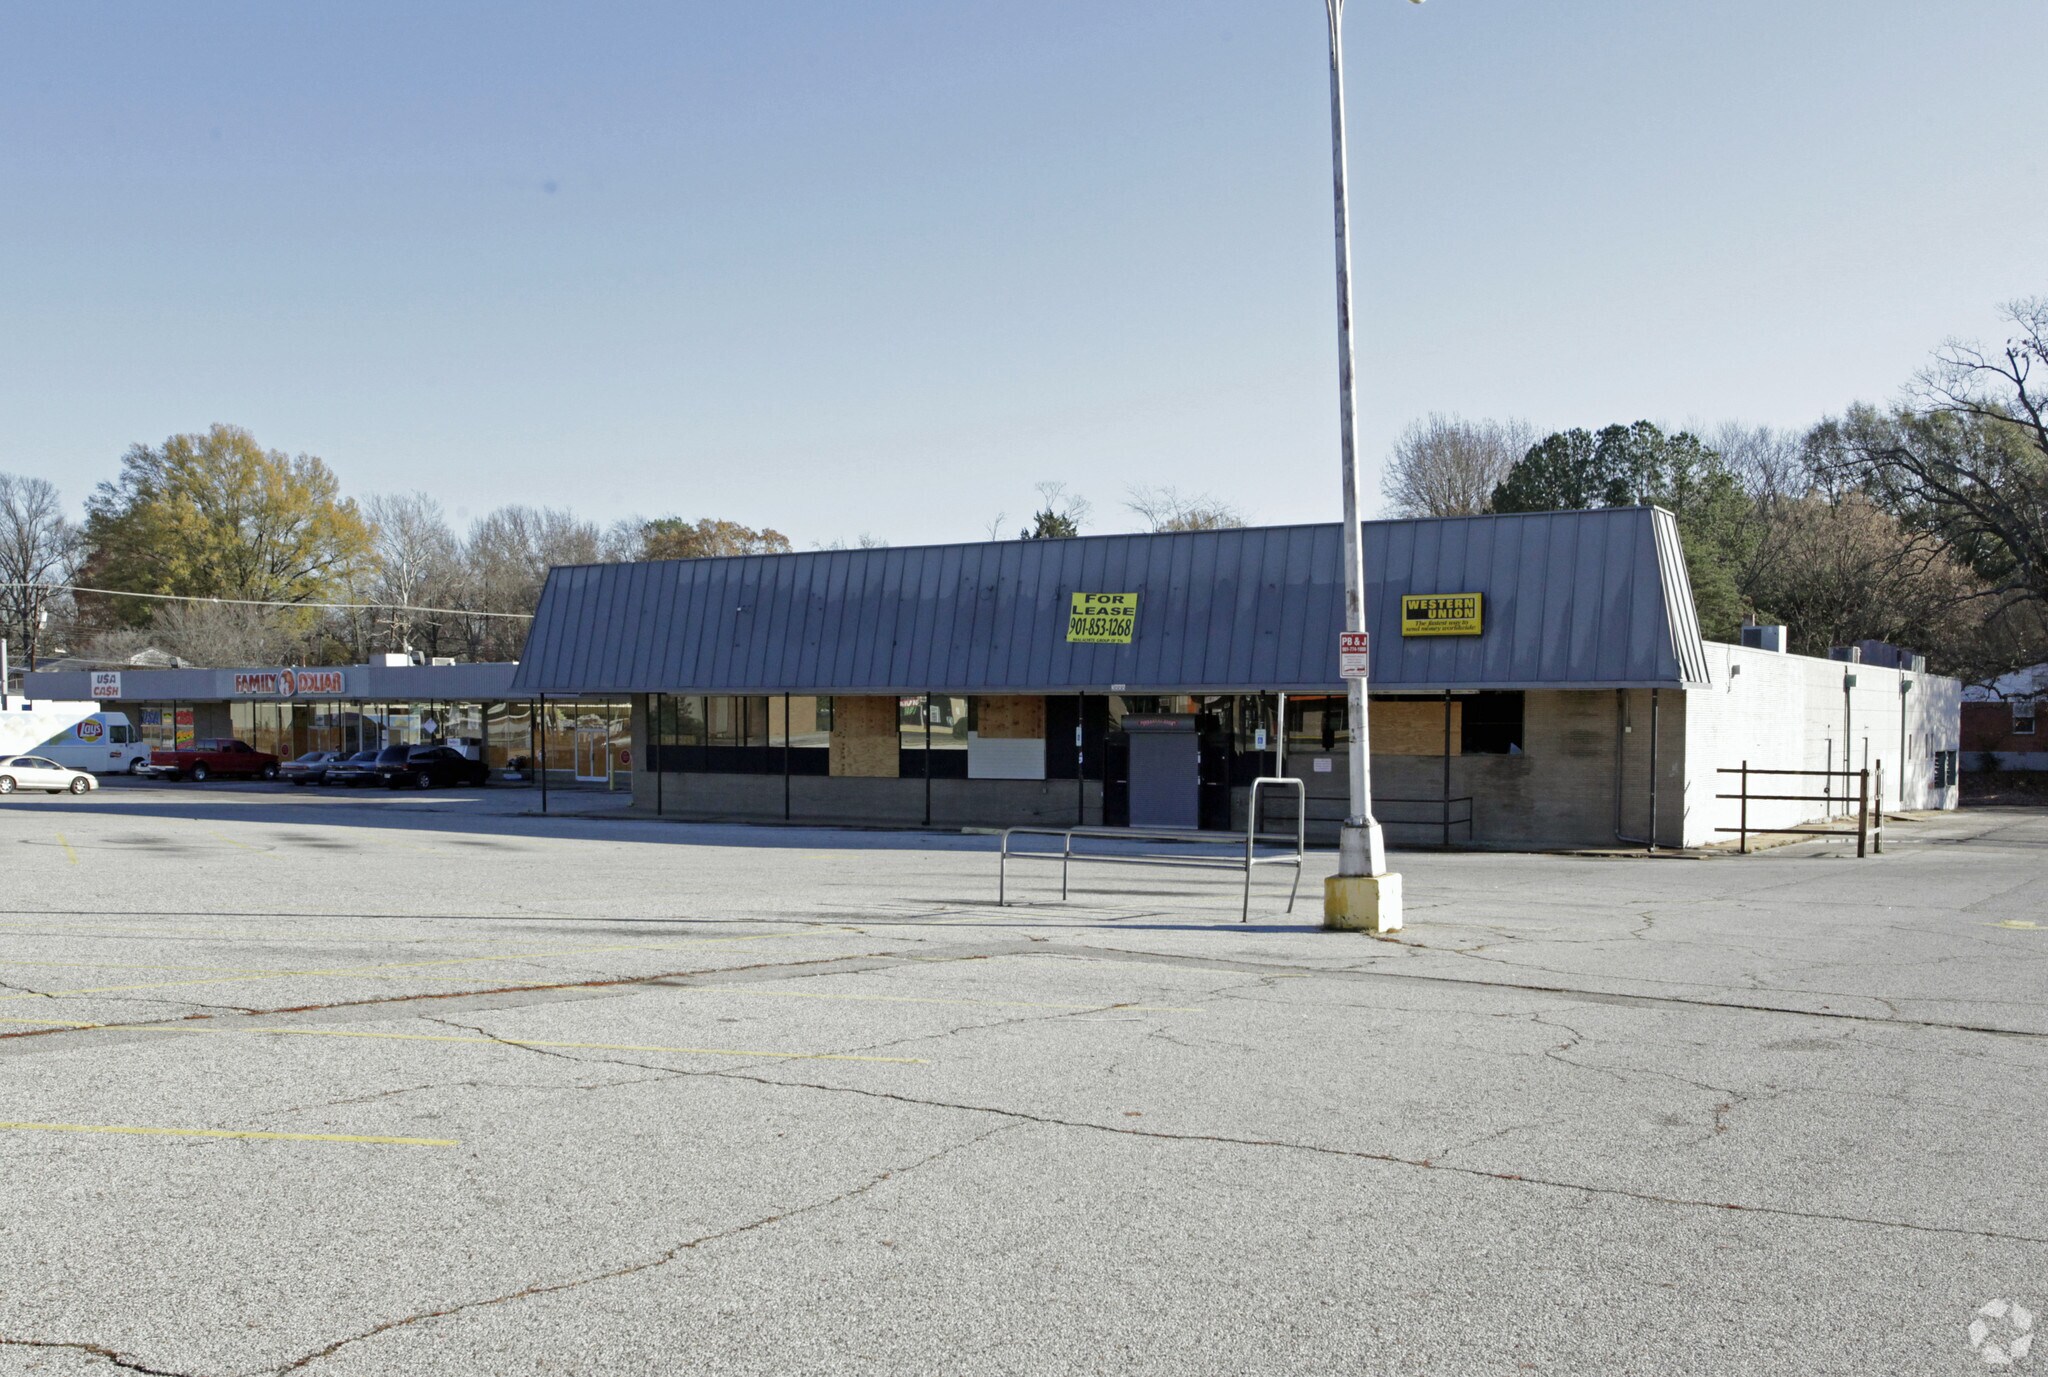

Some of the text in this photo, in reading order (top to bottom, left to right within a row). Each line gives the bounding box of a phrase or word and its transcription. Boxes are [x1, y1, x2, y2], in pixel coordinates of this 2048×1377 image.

[1085, 594, 1125, 604] FOR
[1408, 599, 1473, 609] WESTERN
[1072, 606, 1135, 616] LEASE
[1429, 608, 1473, 618] UNION
[1069, 617, 1132, 636] 901-853-1268
[1342, 637, 1367, 646] PB & J
[235, 674, 277, 692] FAMILY
